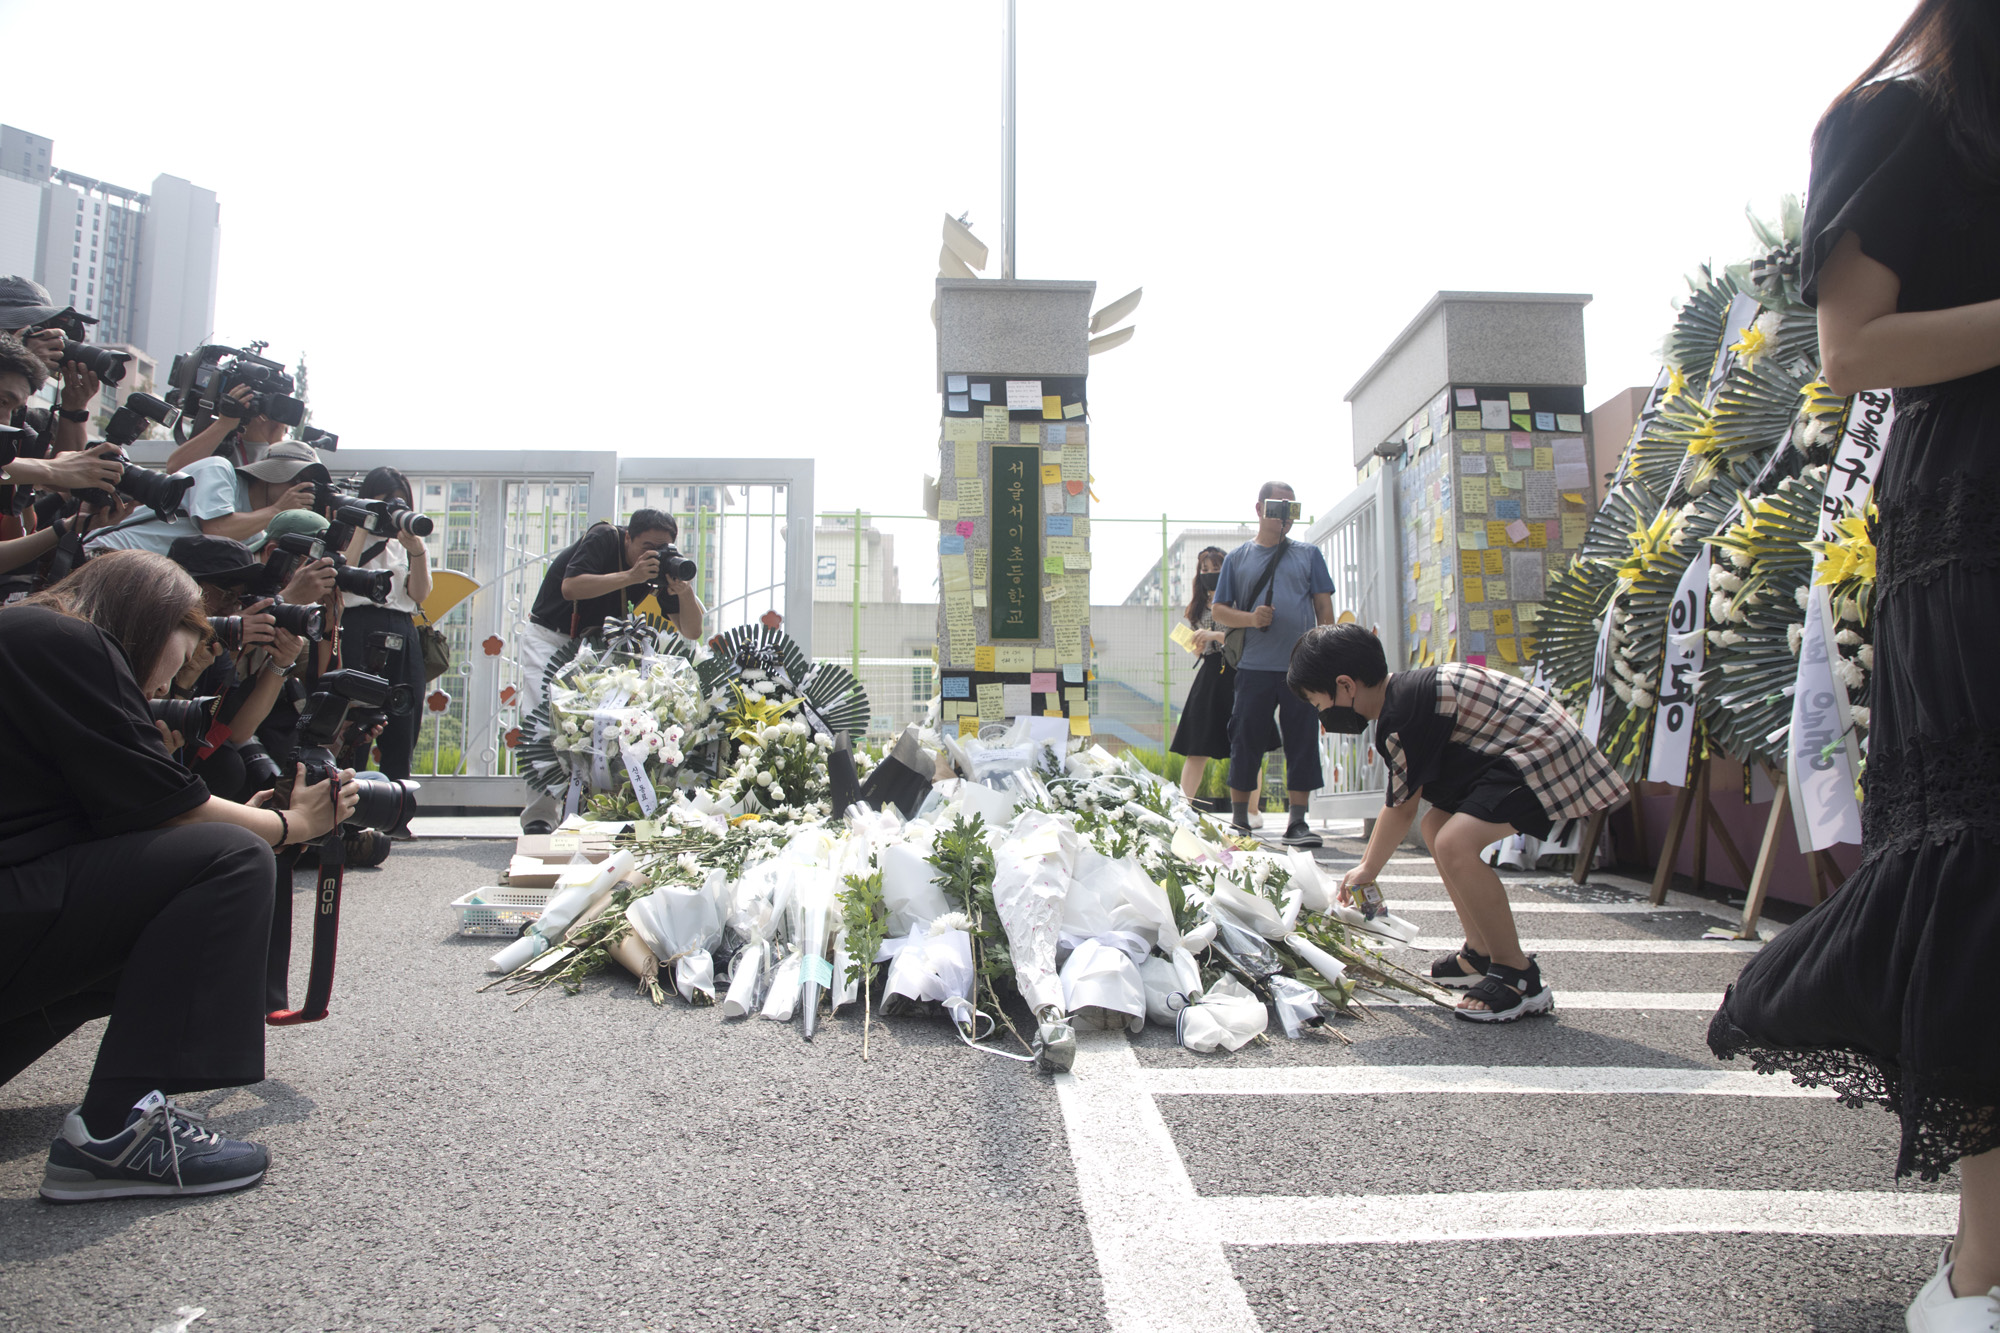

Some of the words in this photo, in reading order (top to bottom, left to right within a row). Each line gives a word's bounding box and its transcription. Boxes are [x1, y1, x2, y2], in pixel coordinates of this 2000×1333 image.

[1006, 460, 1025, 624] 서울서이초등학교
[210, 695, 222, 716] anon
[321, 877, 336, 915] EOS
